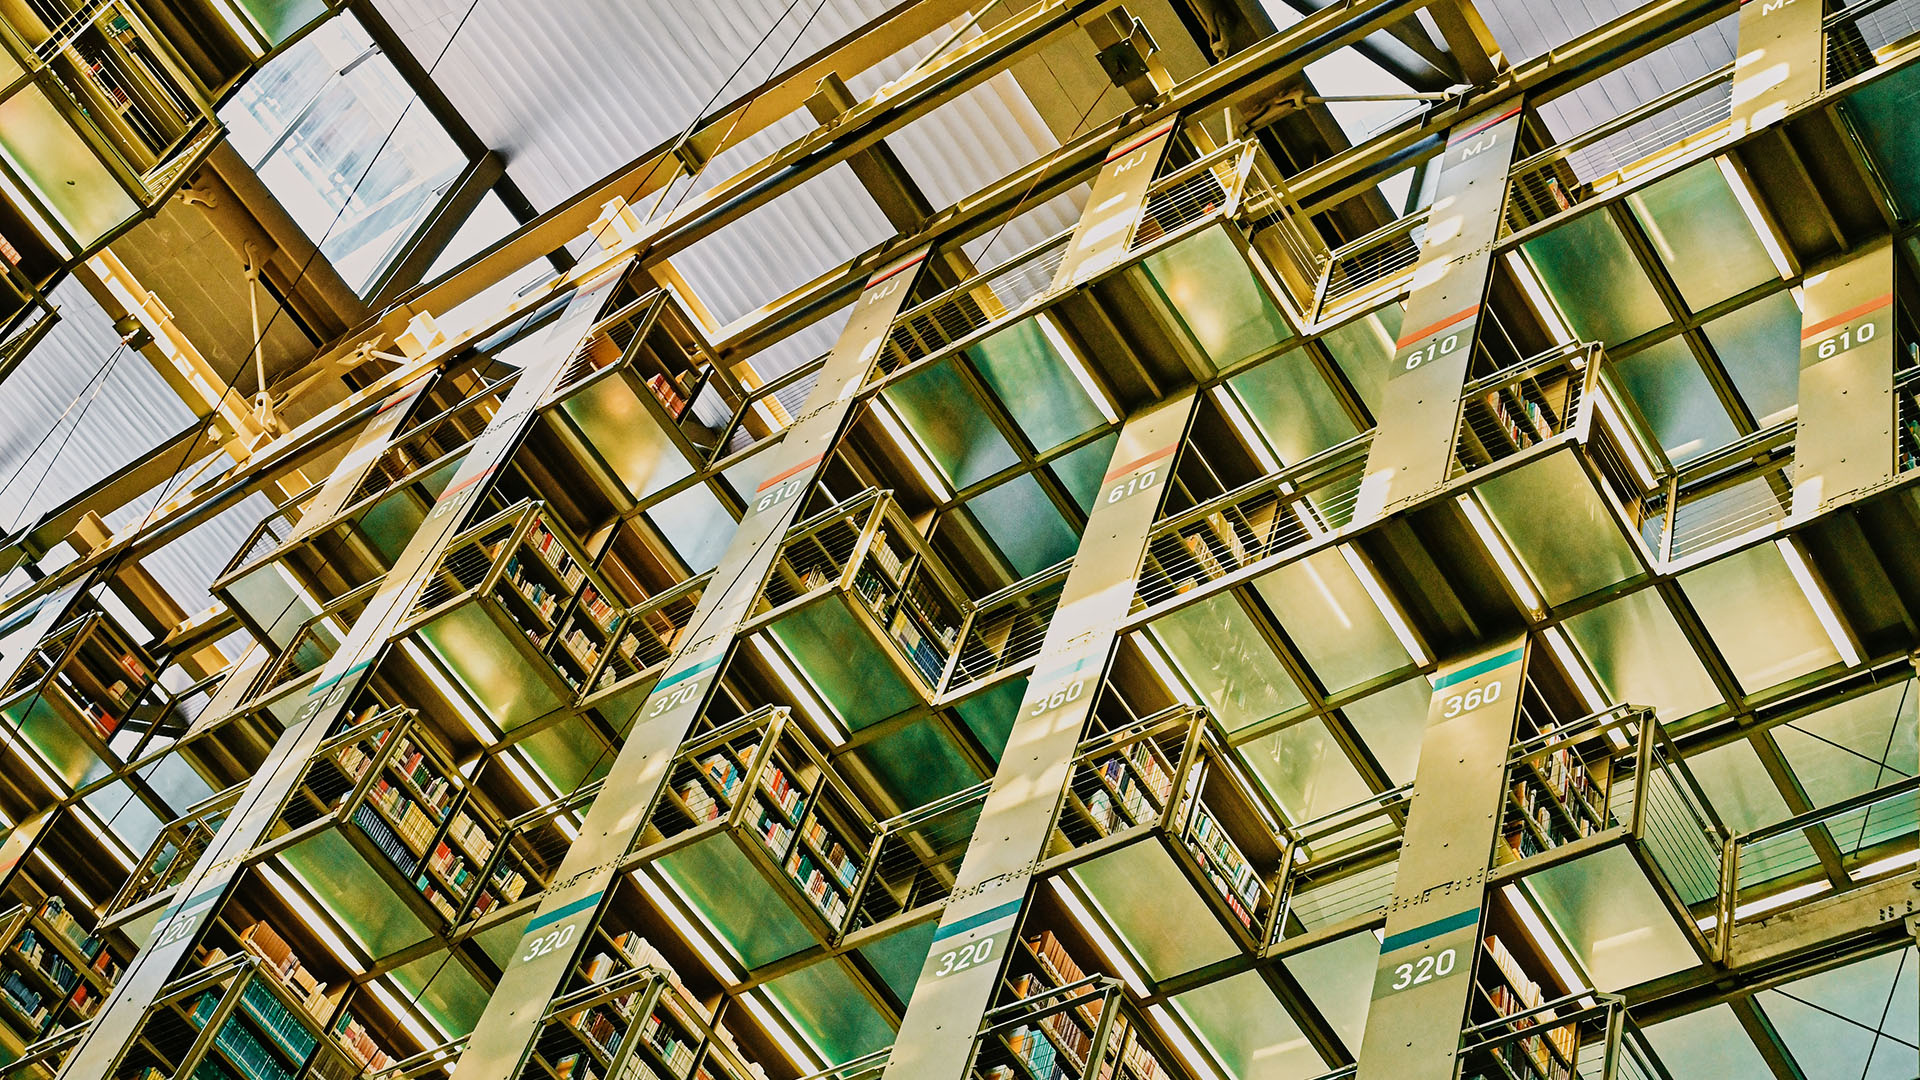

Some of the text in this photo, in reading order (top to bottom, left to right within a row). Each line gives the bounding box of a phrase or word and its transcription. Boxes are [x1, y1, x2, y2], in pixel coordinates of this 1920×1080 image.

[1113, 151, 1147, 177] MJ
[1461, 134, 1497, 161] MJ
[568, 299, 595, 318] MJ
[868, 280, 900, 304] MJ
[1405, 335, 1458, 371] 610
[1818, 322, 1875, 360] 610
[372, 409, 401, 430] MJ
[433, 488, 472, 519] 610
[756, 479, 802, 512] 610
[1107, 471, 1157, 504] 610
[649, 682, 698, 718] 370
[1031, 680, 1084, 717] 360
[1443, 680, 1502, 718] 360
[523, 923, 576, 962] 320
[935, 937, 994, 977] 320
[1391, 949, 1456, 991] 320
